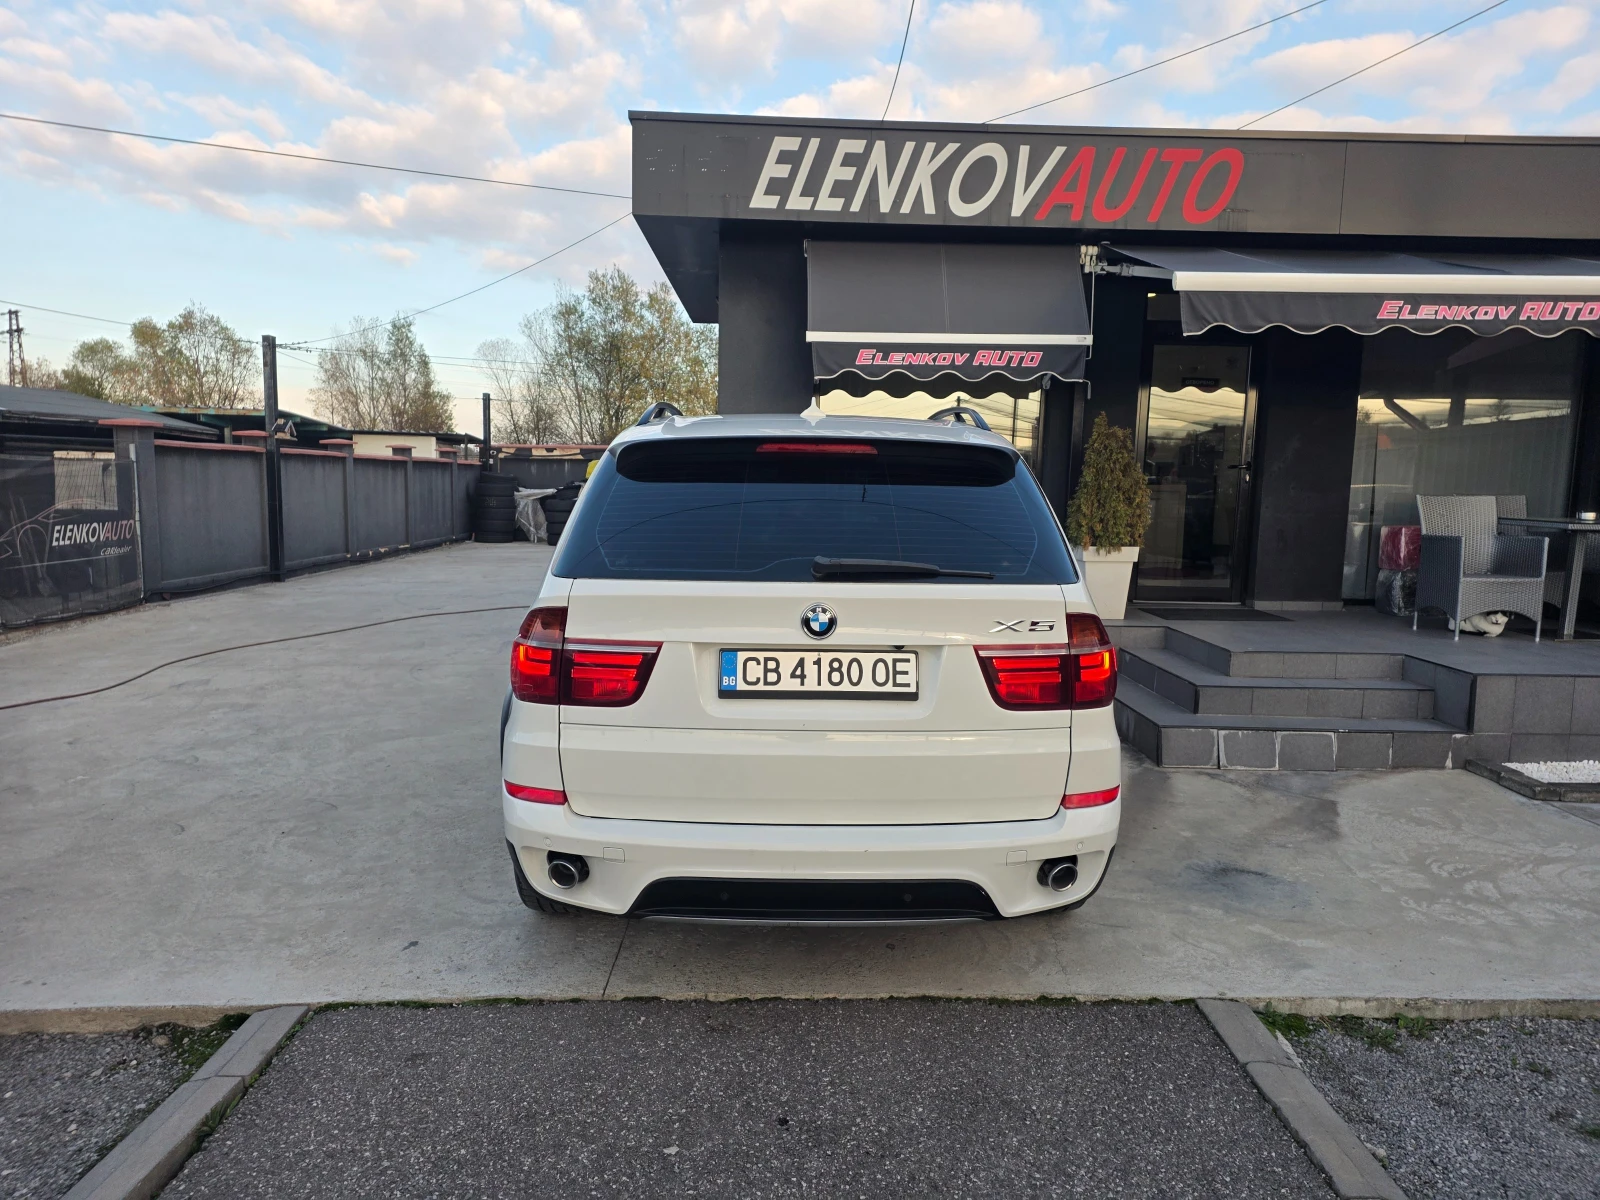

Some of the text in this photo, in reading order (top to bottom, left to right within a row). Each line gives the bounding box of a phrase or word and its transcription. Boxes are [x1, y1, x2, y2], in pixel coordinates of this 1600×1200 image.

[1519, 301, 1600, 321] AUTO
[973, 350, 1043, 367] AUTO
[806, 607, 832, 618] BMW
[988, 619, 1056, 633] X5
[742, 656, 911, 688] CB 4180 OE
[723, 676, 736, 685] BG
